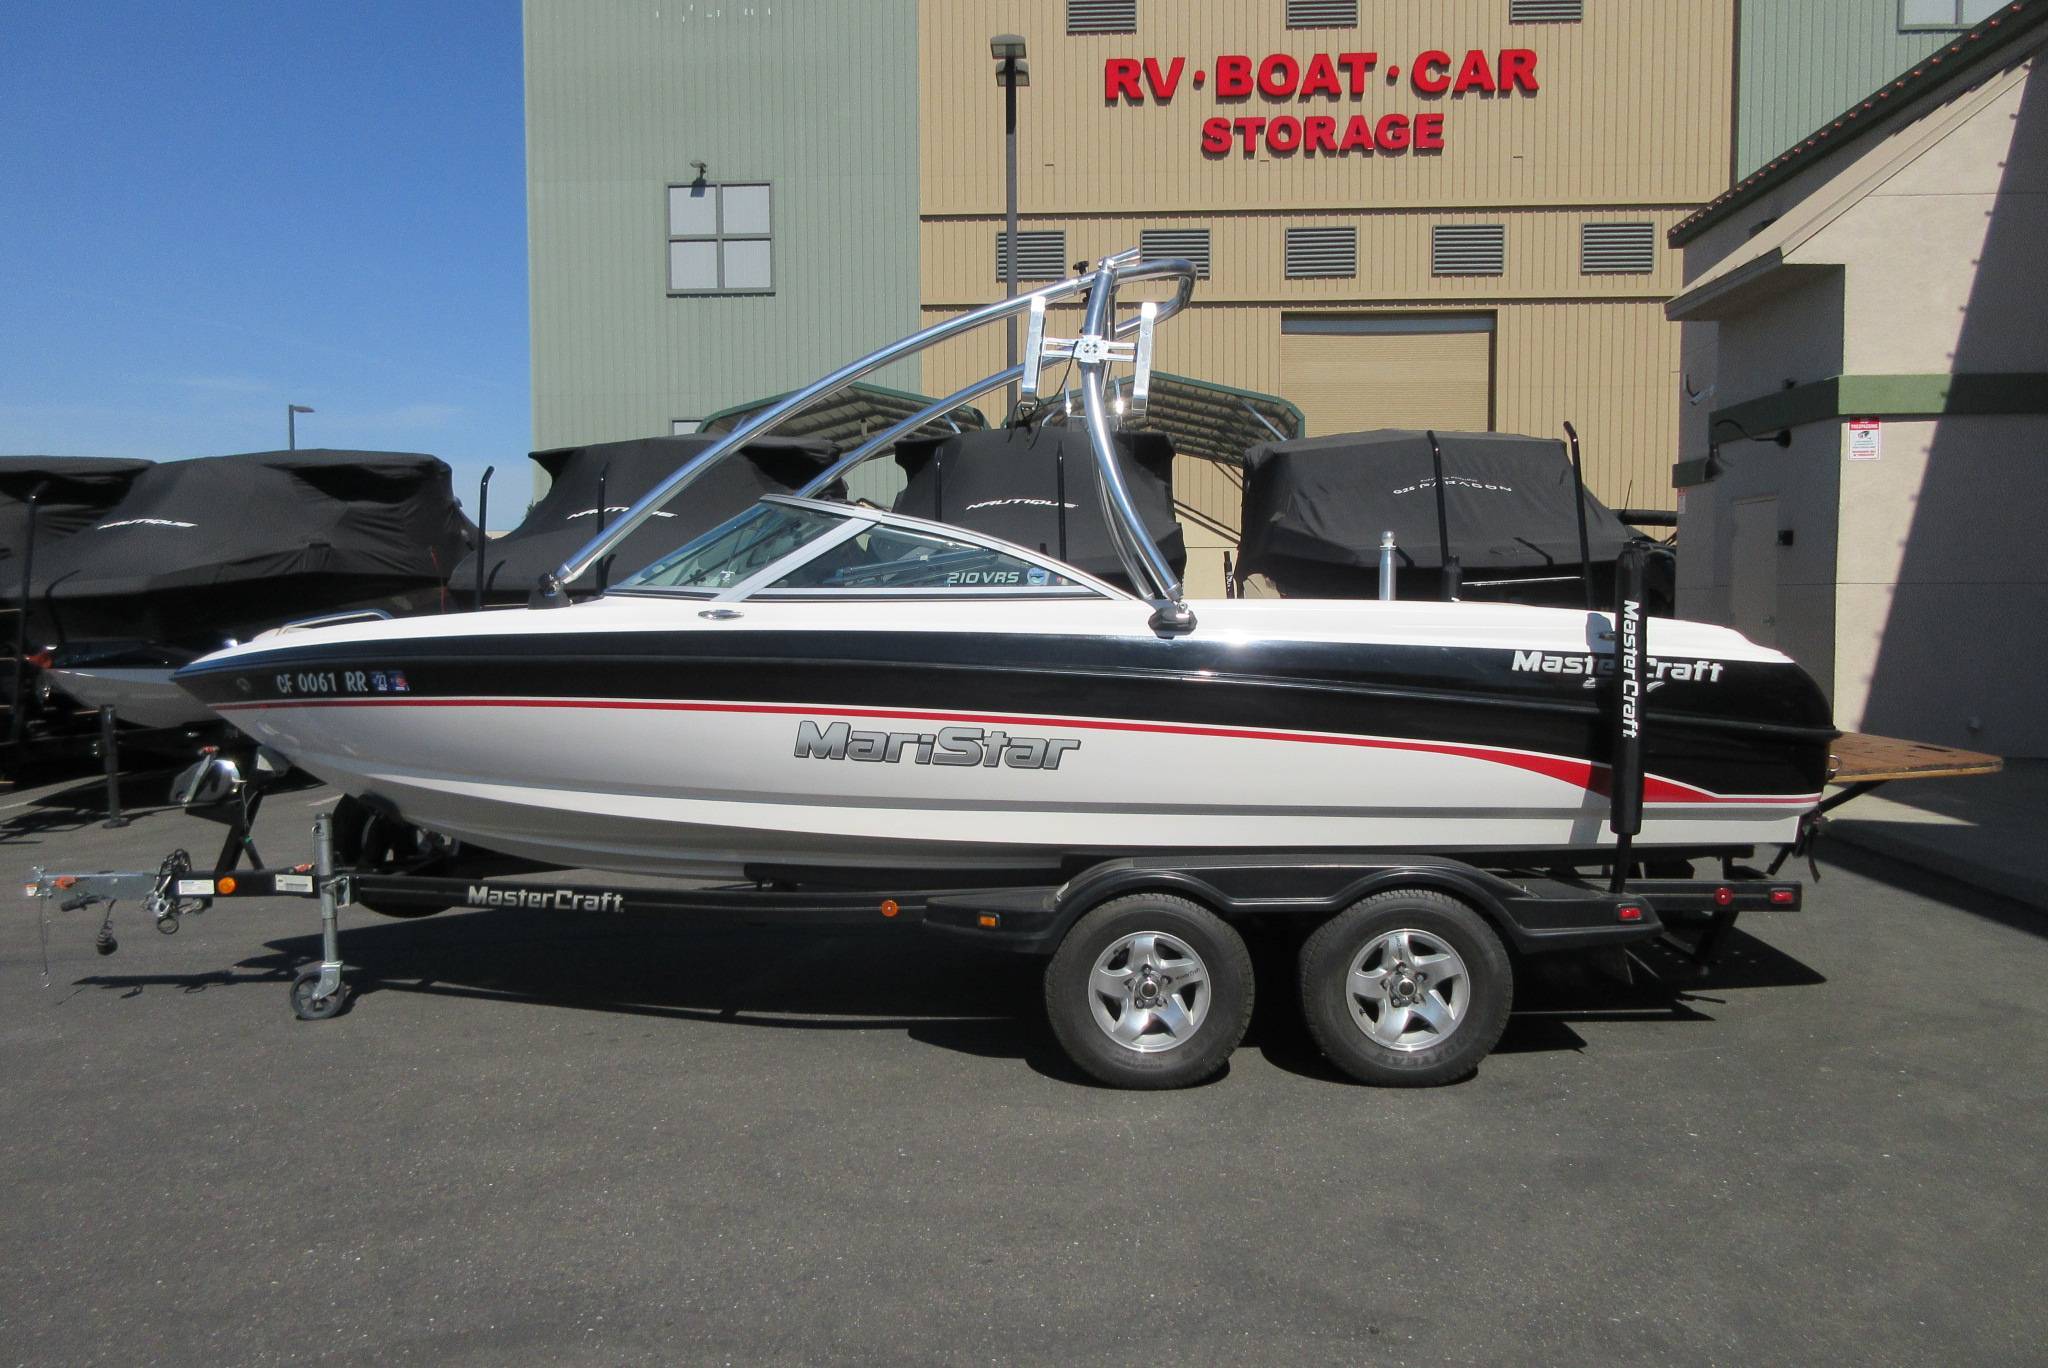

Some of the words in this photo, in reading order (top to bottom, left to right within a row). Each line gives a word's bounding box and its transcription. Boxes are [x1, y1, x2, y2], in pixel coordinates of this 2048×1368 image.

[1104, 57, 1186, 101] RV
[1215, 52, 1378, 99] BOAT
[1410, 49, 1540, 94] CAR
[1201, 113, 1446, 154] STORAGE
[276, 673, 293, 693] CF
[298, 672, 337, 692] 0061
[345, 671, 368, 692] RR
[1622, 599, 1641, 740] MasterCraft
[794, 720, 1081, 770] MariStar
[467, 885, 625, 914] MasterCraft
